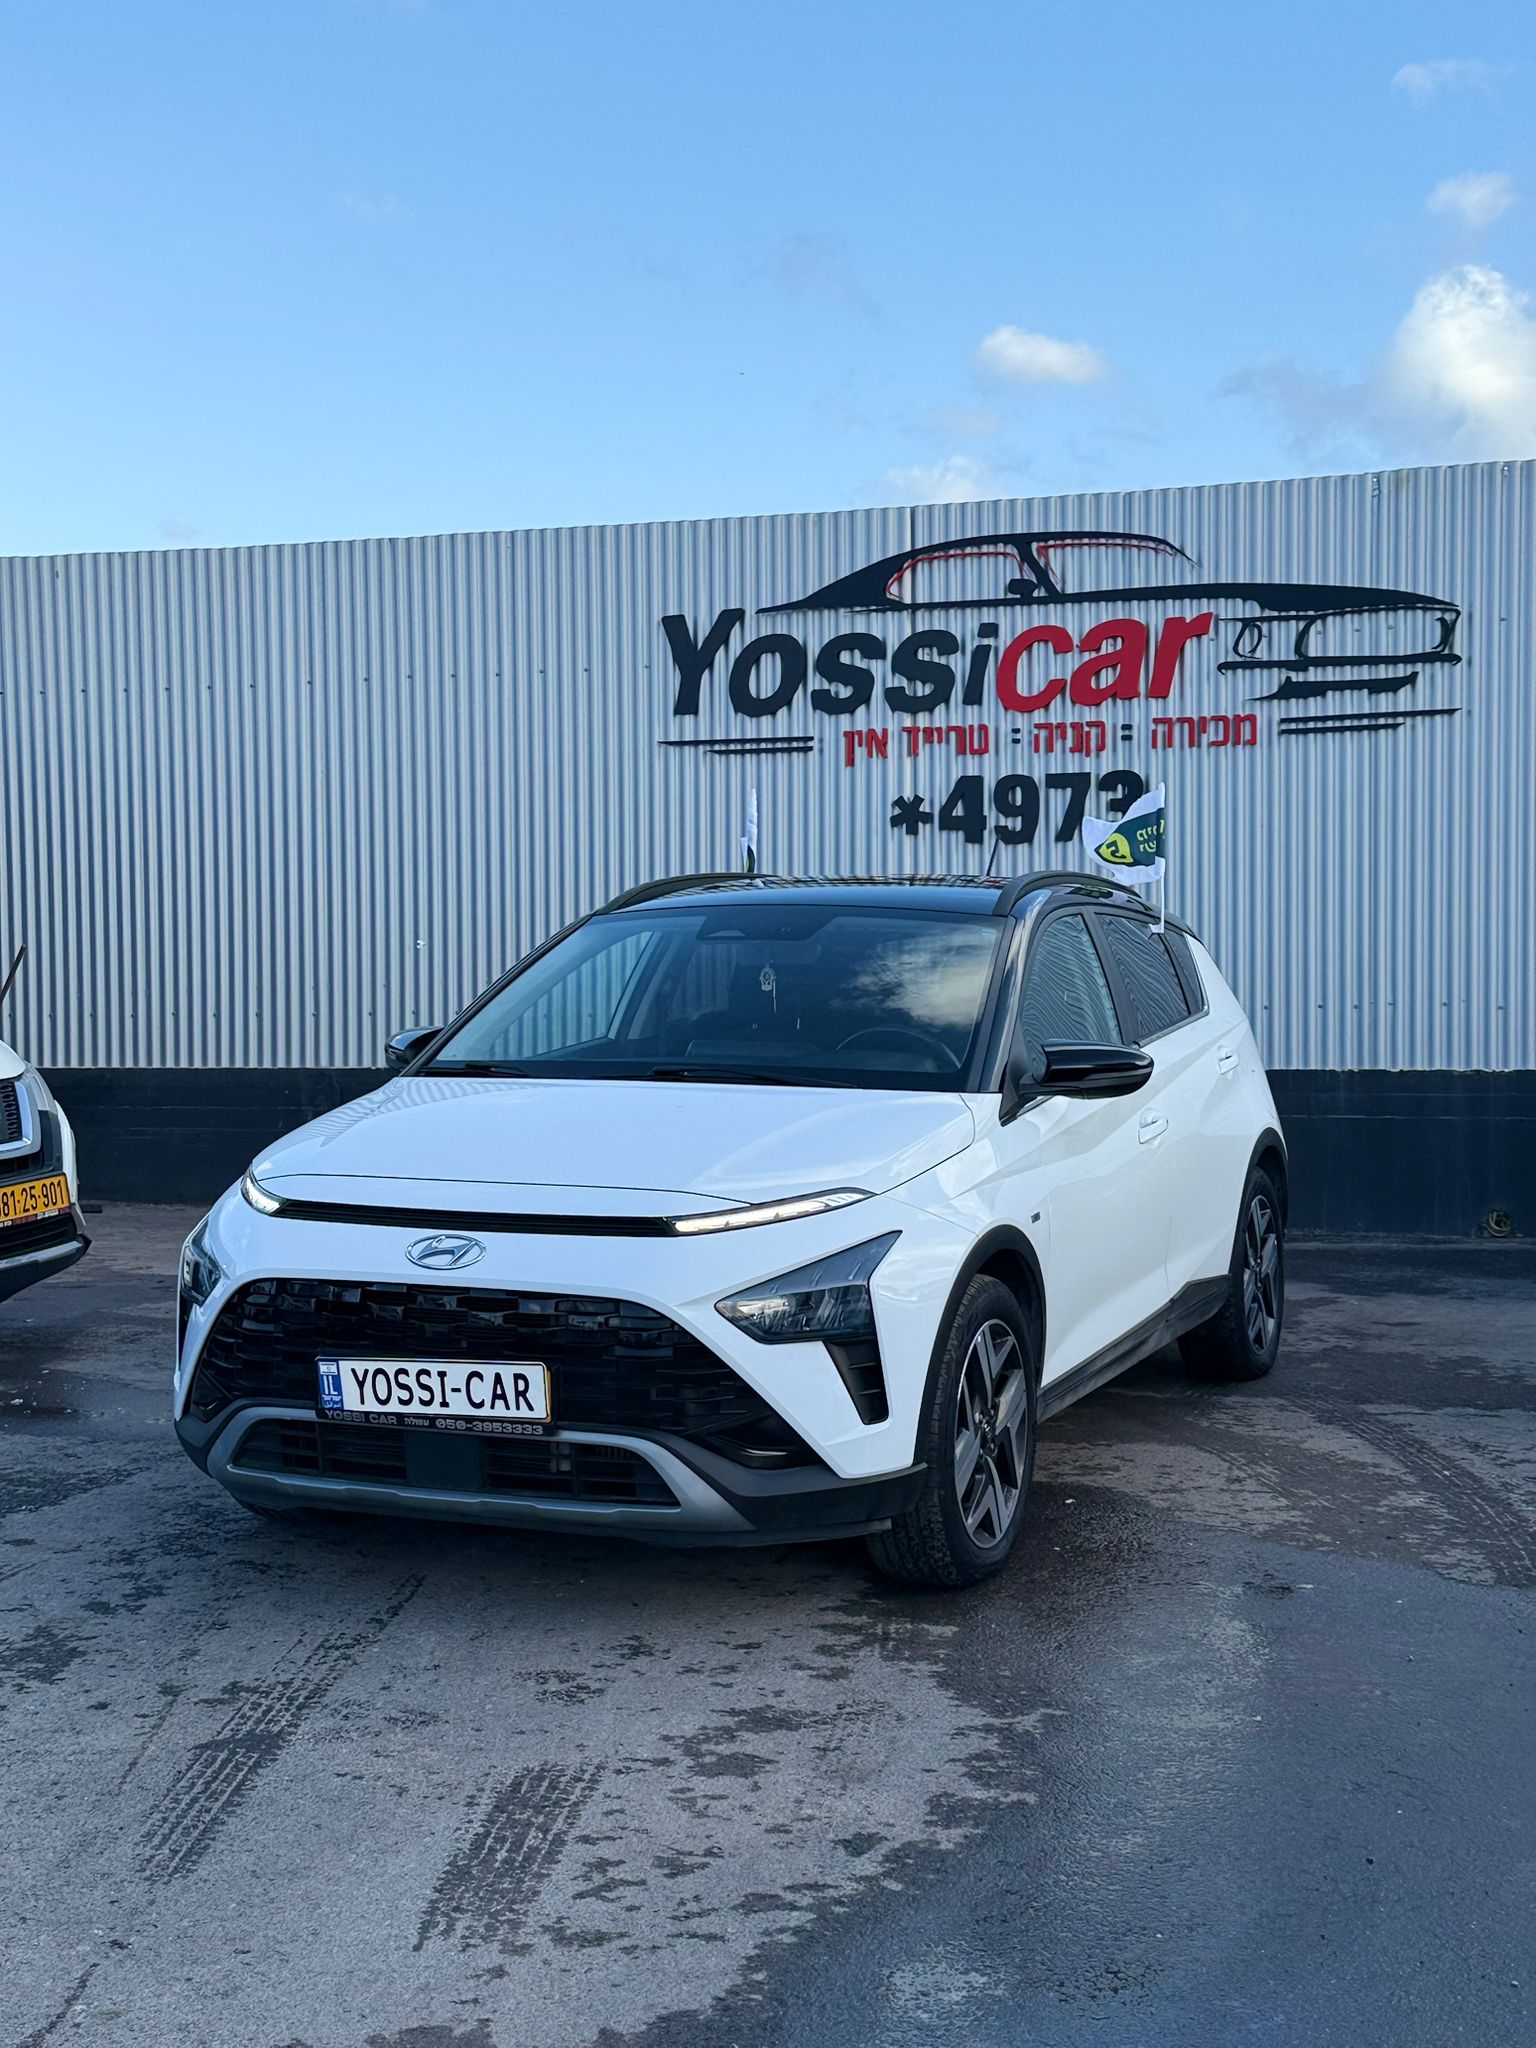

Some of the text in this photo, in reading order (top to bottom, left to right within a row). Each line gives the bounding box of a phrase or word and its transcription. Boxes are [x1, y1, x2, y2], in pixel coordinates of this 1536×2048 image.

[843, 713, 1257, 767] מכירה קניה טרייד אין
[323, 1375, 339, 1395] IL
[350, 1367, 535, 1412] YOSSI-CAR
[325, 1409, 366, 1423] YOSSI
[369, 1413, 398, 1425] CAR
[435, 1415, 544, 1435] 050-3953333
